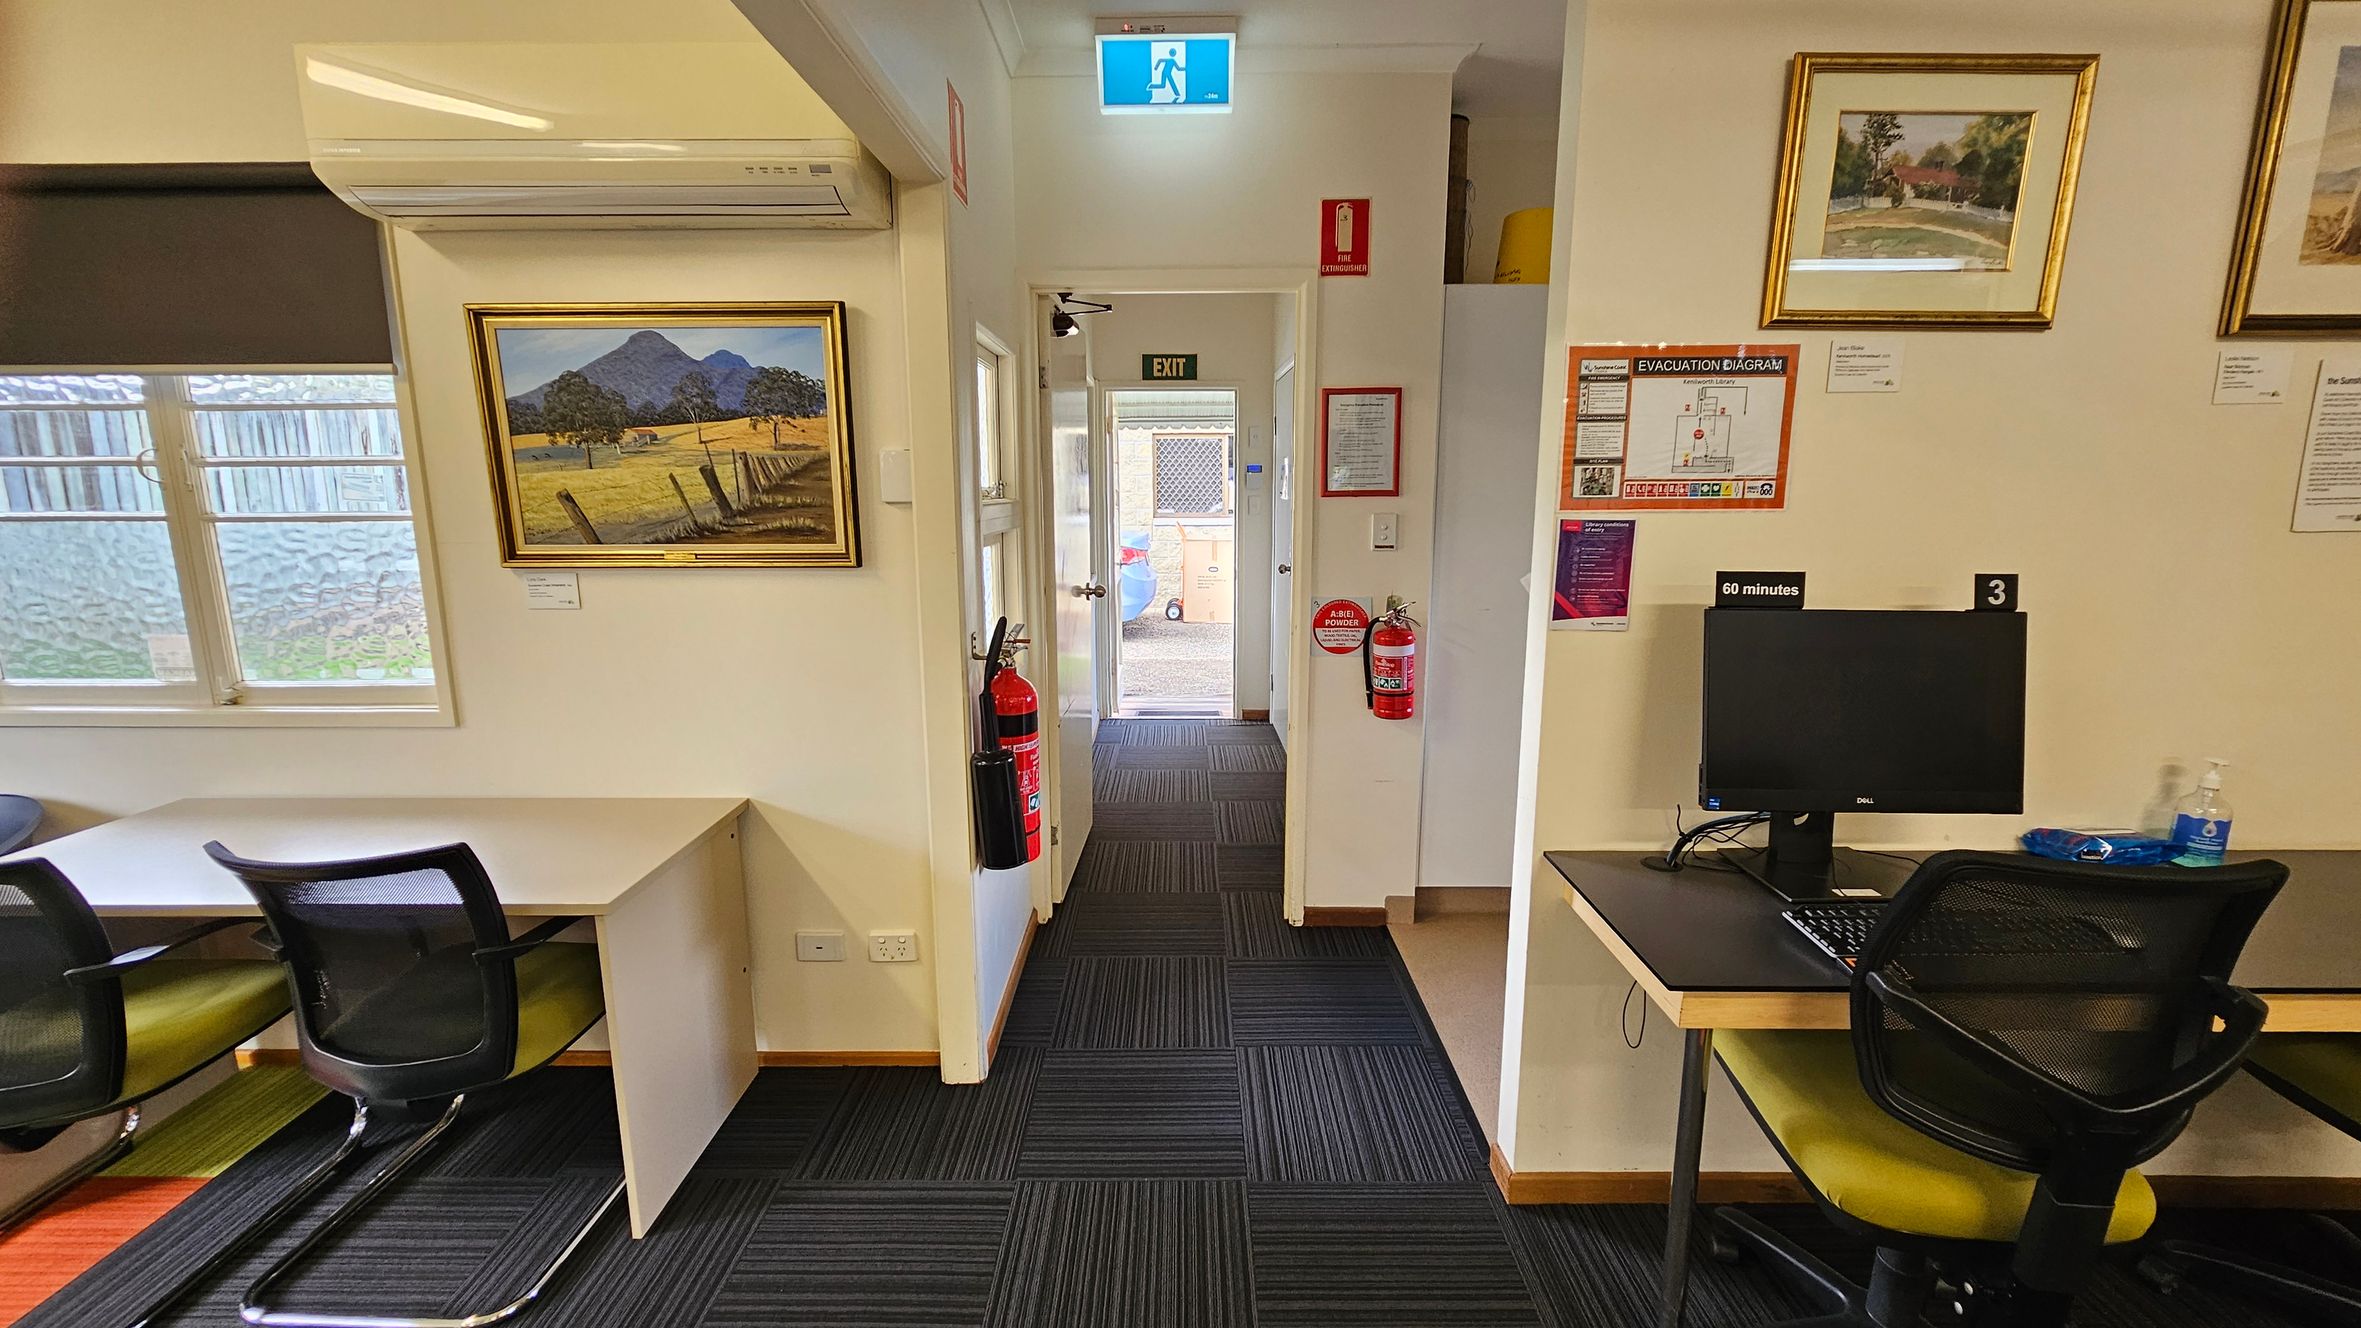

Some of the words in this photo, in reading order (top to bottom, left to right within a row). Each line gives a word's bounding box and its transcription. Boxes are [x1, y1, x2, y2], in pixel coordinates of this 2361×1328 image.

[1337, 254, 1352, 263] FIRE
[1321, 264, 1367, 272] EXTINGUISHER
[1153, 357, 1186, 377] EXIT
[1638, 359, 1720, 372] EVACUATION
[1722, 358, 1783, 371] DIAGRAM
[1683, 378, 1715, 386] Kenilworth
[1716, 378, 1736, 386] Library
[1722, 582, 1739, 595] 60
[1742, 582, 1800, 596] minutes
[1987, 579, 2006, 605] 3
[1330, 610, 1354, 618] A:B(E)
